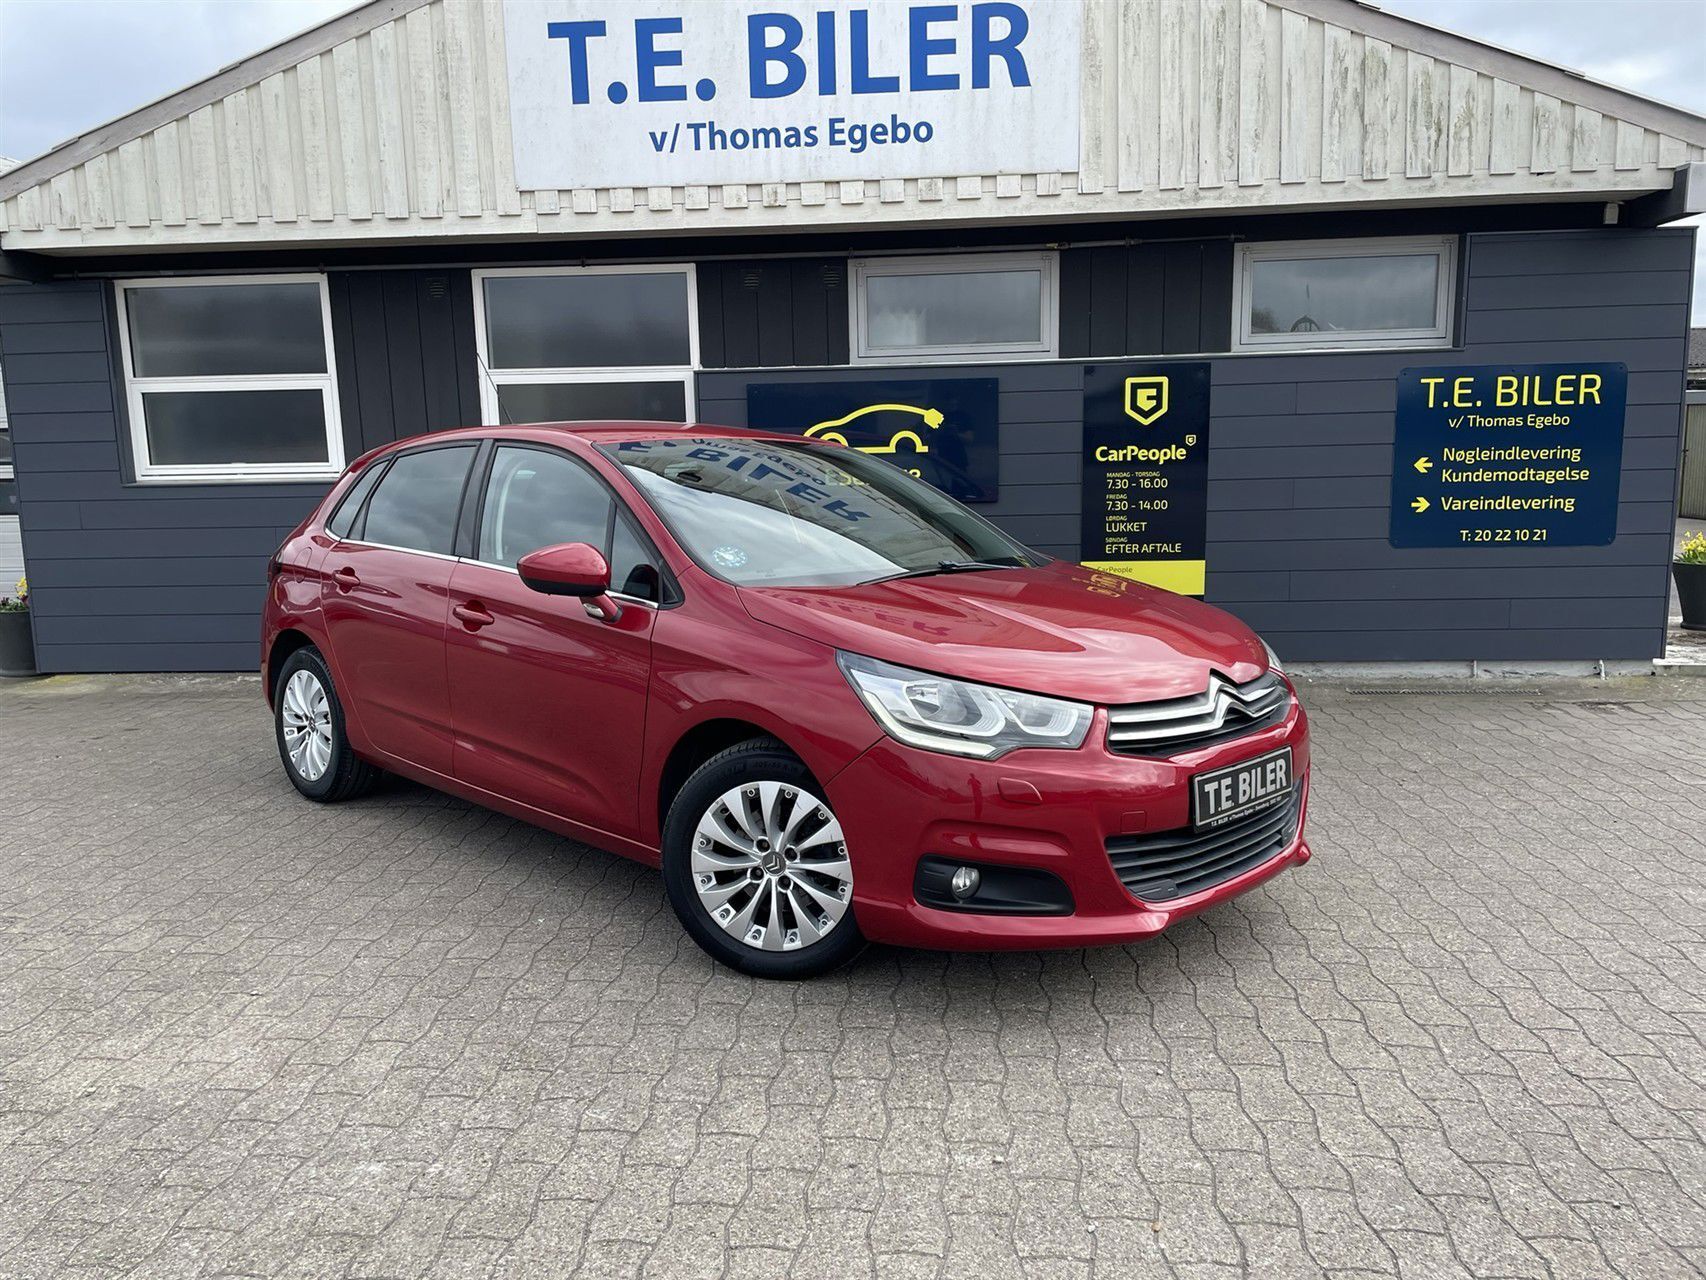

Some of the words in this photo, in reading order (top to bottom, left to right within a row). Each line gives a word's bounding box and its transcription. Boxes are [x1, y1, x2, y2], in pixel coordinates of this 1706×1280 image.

[548, 17, 716, 105] T.E.
[747, 2, 1032, 99] BILER
[648, 122, 680, 153] v/
[687, 118, 818, 151] Thomas
[828, 114, 934, 153] Egebo
[1420, 377, 1482, 408] T.E.
[1496, 374, 1602, 407] BILER
[1448, 416, 1465, 428] v/
[1467, 414, 1523, 427] Thomas
[1527, 413, 1570, 429] Egebo
[1095, 444, 1187, 465] CarPeople
[1443, 446, 1582, 465] Nøgleindlevering
[1106, 479, 1129, 489] 7.30
[1139, 478, 1168, 488] 16.00
[1441, 467, 1590, 484] Kundemodtagelse
[1106, 501, 1128, 511] 7.30
[1139, 500, 1168, 510] 14.00
[1441, 495, 1576, 513] Vareindlevering
[1106, 522, 1147, 532] LUKKET
[1460, 530, 1471, 541] T:
[1474, 530, 1492, 541] 20
[1495, 529, 1511, 541] 22
[1514, 529, 1530, 540] 10
[1533, 529, 1547, 540] 21
[1105, 544, 1139, 553] EFTER
[1141, 543, 1182, 553] AFTALE
[1239, 758, 1287, 804] BILER
